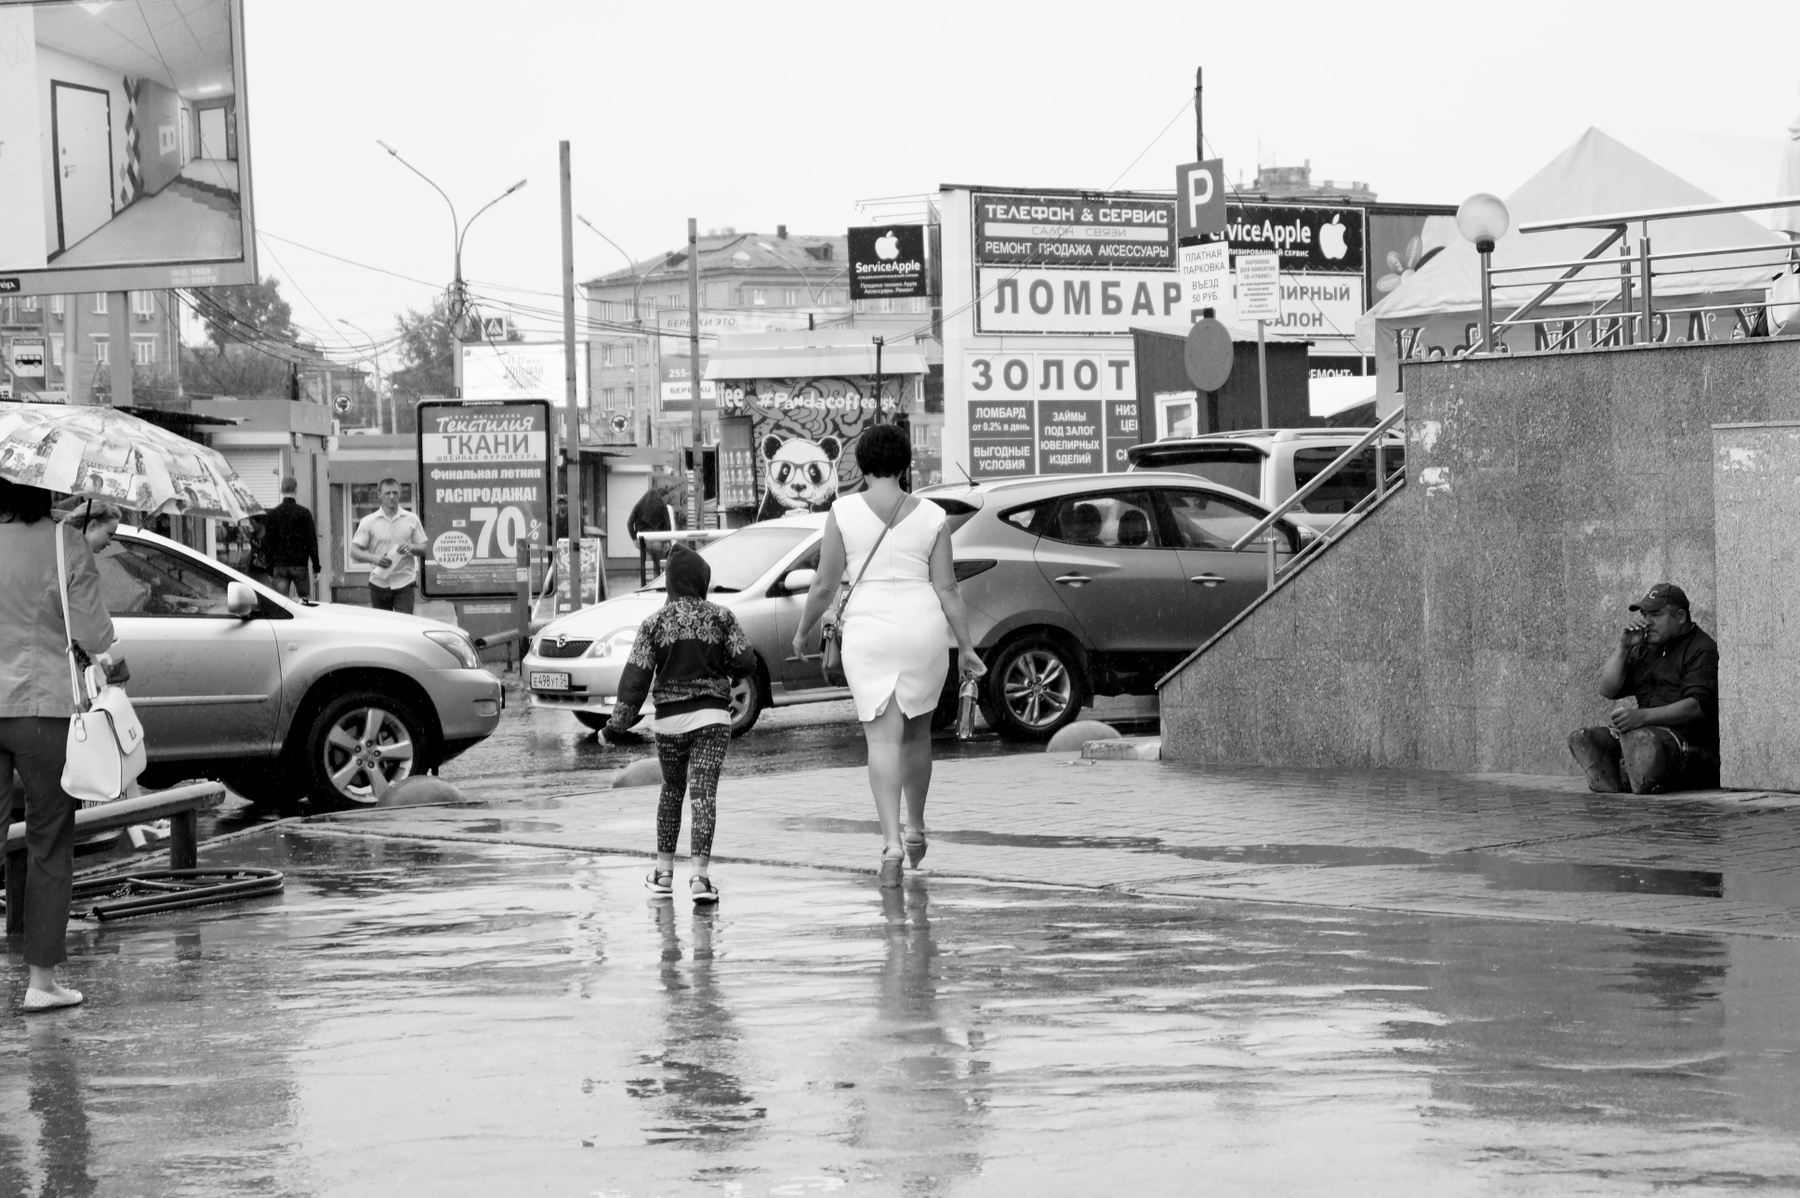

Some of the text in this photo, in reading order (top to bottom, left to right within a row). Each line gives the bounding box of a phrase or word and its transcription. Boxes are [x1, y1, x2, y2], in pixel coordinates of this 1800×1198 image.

[985, 204, 1168, 223] ТЕЛЕФОН & СЕРВИС
[1032, 226, 1127, 237] САЛОН СВЯЗИ
[985, 241, 1169, 258] РЕМОНТ ПРОДАЖА АКСЕССУАРЫ
[1185, 249, 1222, 262] ПЛАТНАЯ
[855, 259, 921, 274] ServiceApple
[1183, 262, 1225, 275] ПАРКОВКА
[1192, 278, 1219, 291] ВЪЕЗД
[994, 278, 1215, 324] ЛОМБАР
[1192, 291, 1220, 303] 50 РУБ.
[976, 407, 1027, 420] ЛОМБАРД
[1053, 410, 1087, 422] ЗАЙМЫ
[972, 424, 982, 432] от
[983, 423, 1002, 432] 0.2%
[1011, 424, 1031, 433] день
[1045, 426, 1096, 438] ПОД ЗАЛОГ
[442, 433, 529, 455] ТКАНИ
[1041, 439, 1100, 451] ЮВЕЛИРНЫХ
[974, 446, 1031, 459] ВЫГОДНЫЕ
[1050, 452, 1092, 465] ИЗДЕЛИЙ
[980, 459, 1026, 471] УСЛОВИЯ
[430, 467, 541, 480] Финальная летняя
[436, 486, 537, 504] РАСПРОДАЖА!
